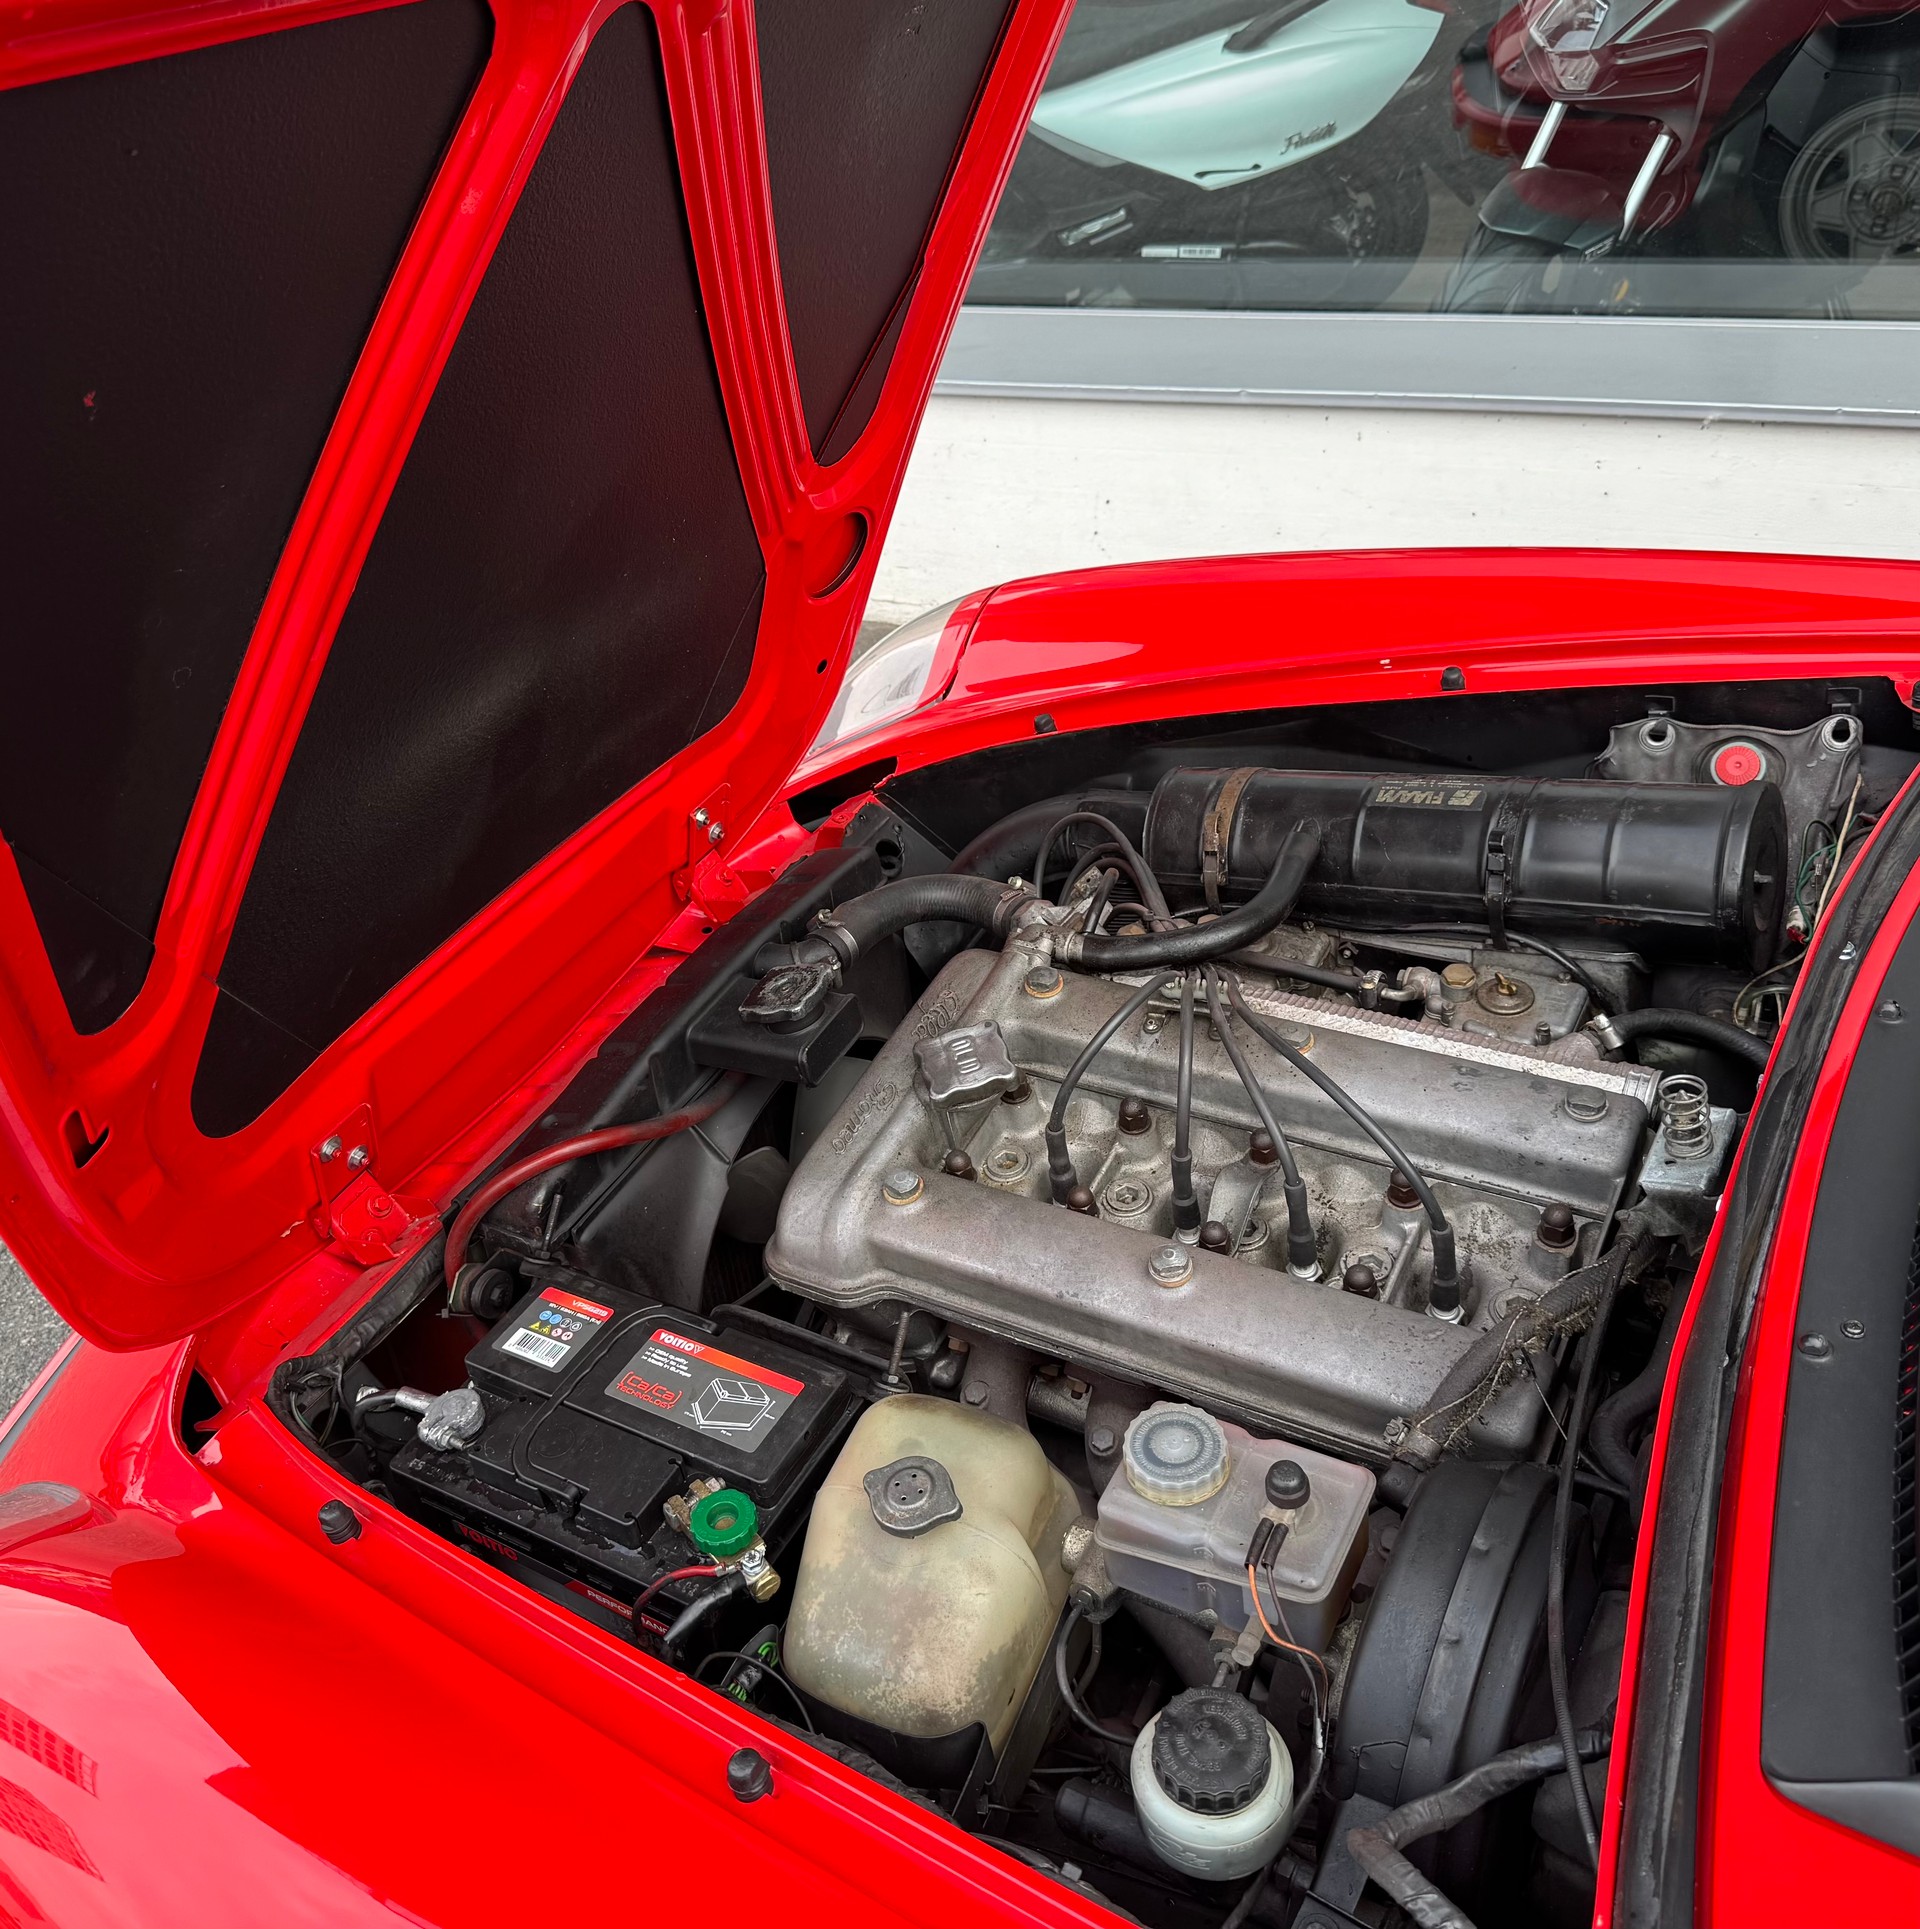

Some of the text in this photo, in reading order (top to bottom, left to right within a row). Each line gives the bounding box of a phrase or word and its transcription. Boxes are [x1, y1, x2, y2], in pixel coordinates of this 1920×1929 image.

[1376, 789, 1445, 805] FIAAM
[659, 1331, 695, 1352] VOLTIO
[616, 1382, 675, 1410] TECHNOLOGY
[459, 1523, 518, 1561] VOLTIO
